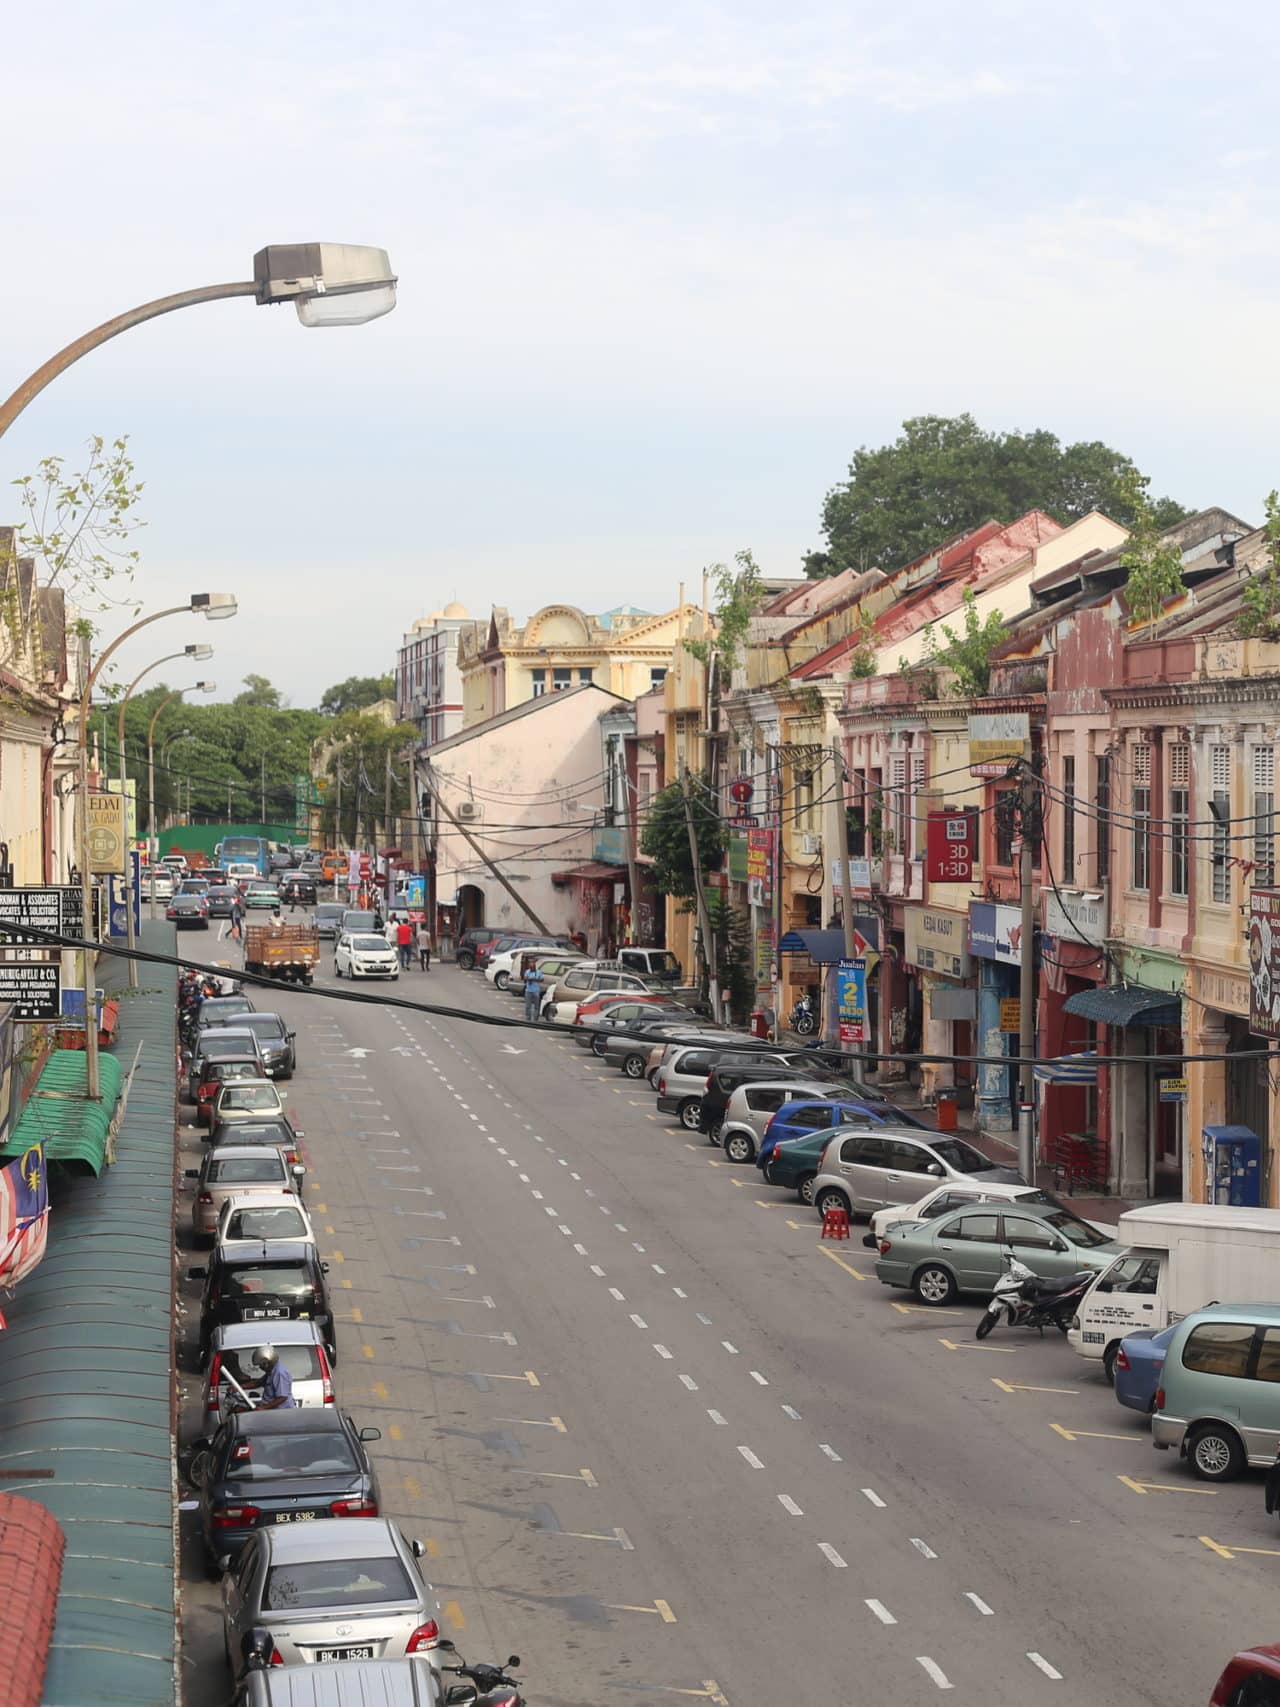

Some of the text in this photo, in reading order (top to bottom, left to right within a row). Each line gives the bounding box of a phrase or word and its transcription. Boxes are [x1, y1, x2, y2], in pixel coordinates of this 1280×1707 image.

[89, 797, 120, 811] EDAI
[949, 844, 969, 859] 3D
[28, 894, 58, 905] ASSOCIATES
[839, 959, 865, 969] Jualan
[46, 968, 57, 981] CO.
[844, 982, 858, 1000] 2
[276, 1511, 316, 1523] BEX 5382
[321, 1650, 340, 1662] BKJ
